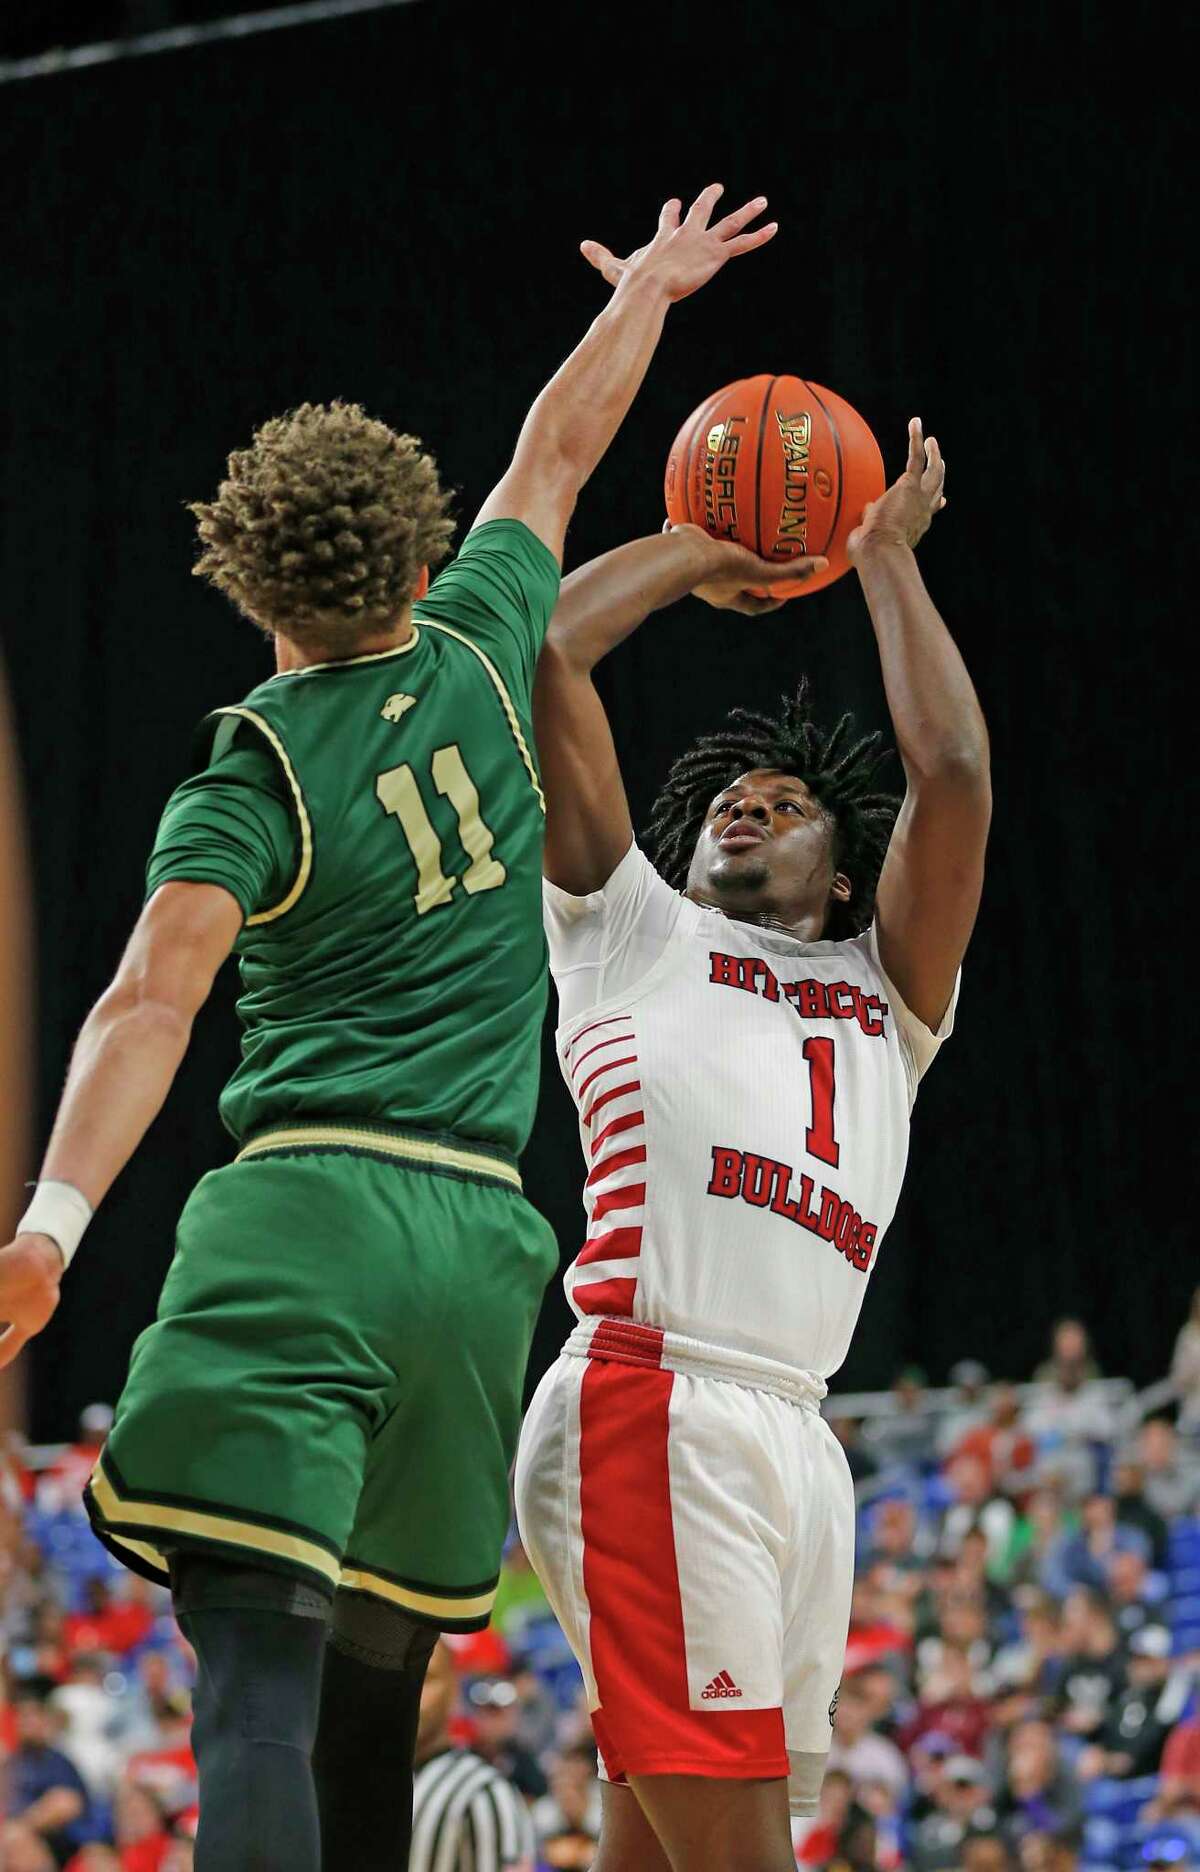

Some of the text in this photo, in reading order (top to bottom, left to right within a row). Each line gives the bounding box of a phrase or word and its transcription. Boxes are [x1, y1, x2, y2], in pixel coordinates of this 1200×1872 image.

[716, 416, 748, 543] LEGACY
[774, 408, 812, 555] SPALDING
[375, 742, 506, 915] 11
[802, 1035, 840, 1169] 1
[707, 1146, 878, 1272] BULLDOGS
[701, 1687, 743, 1699] adidas
